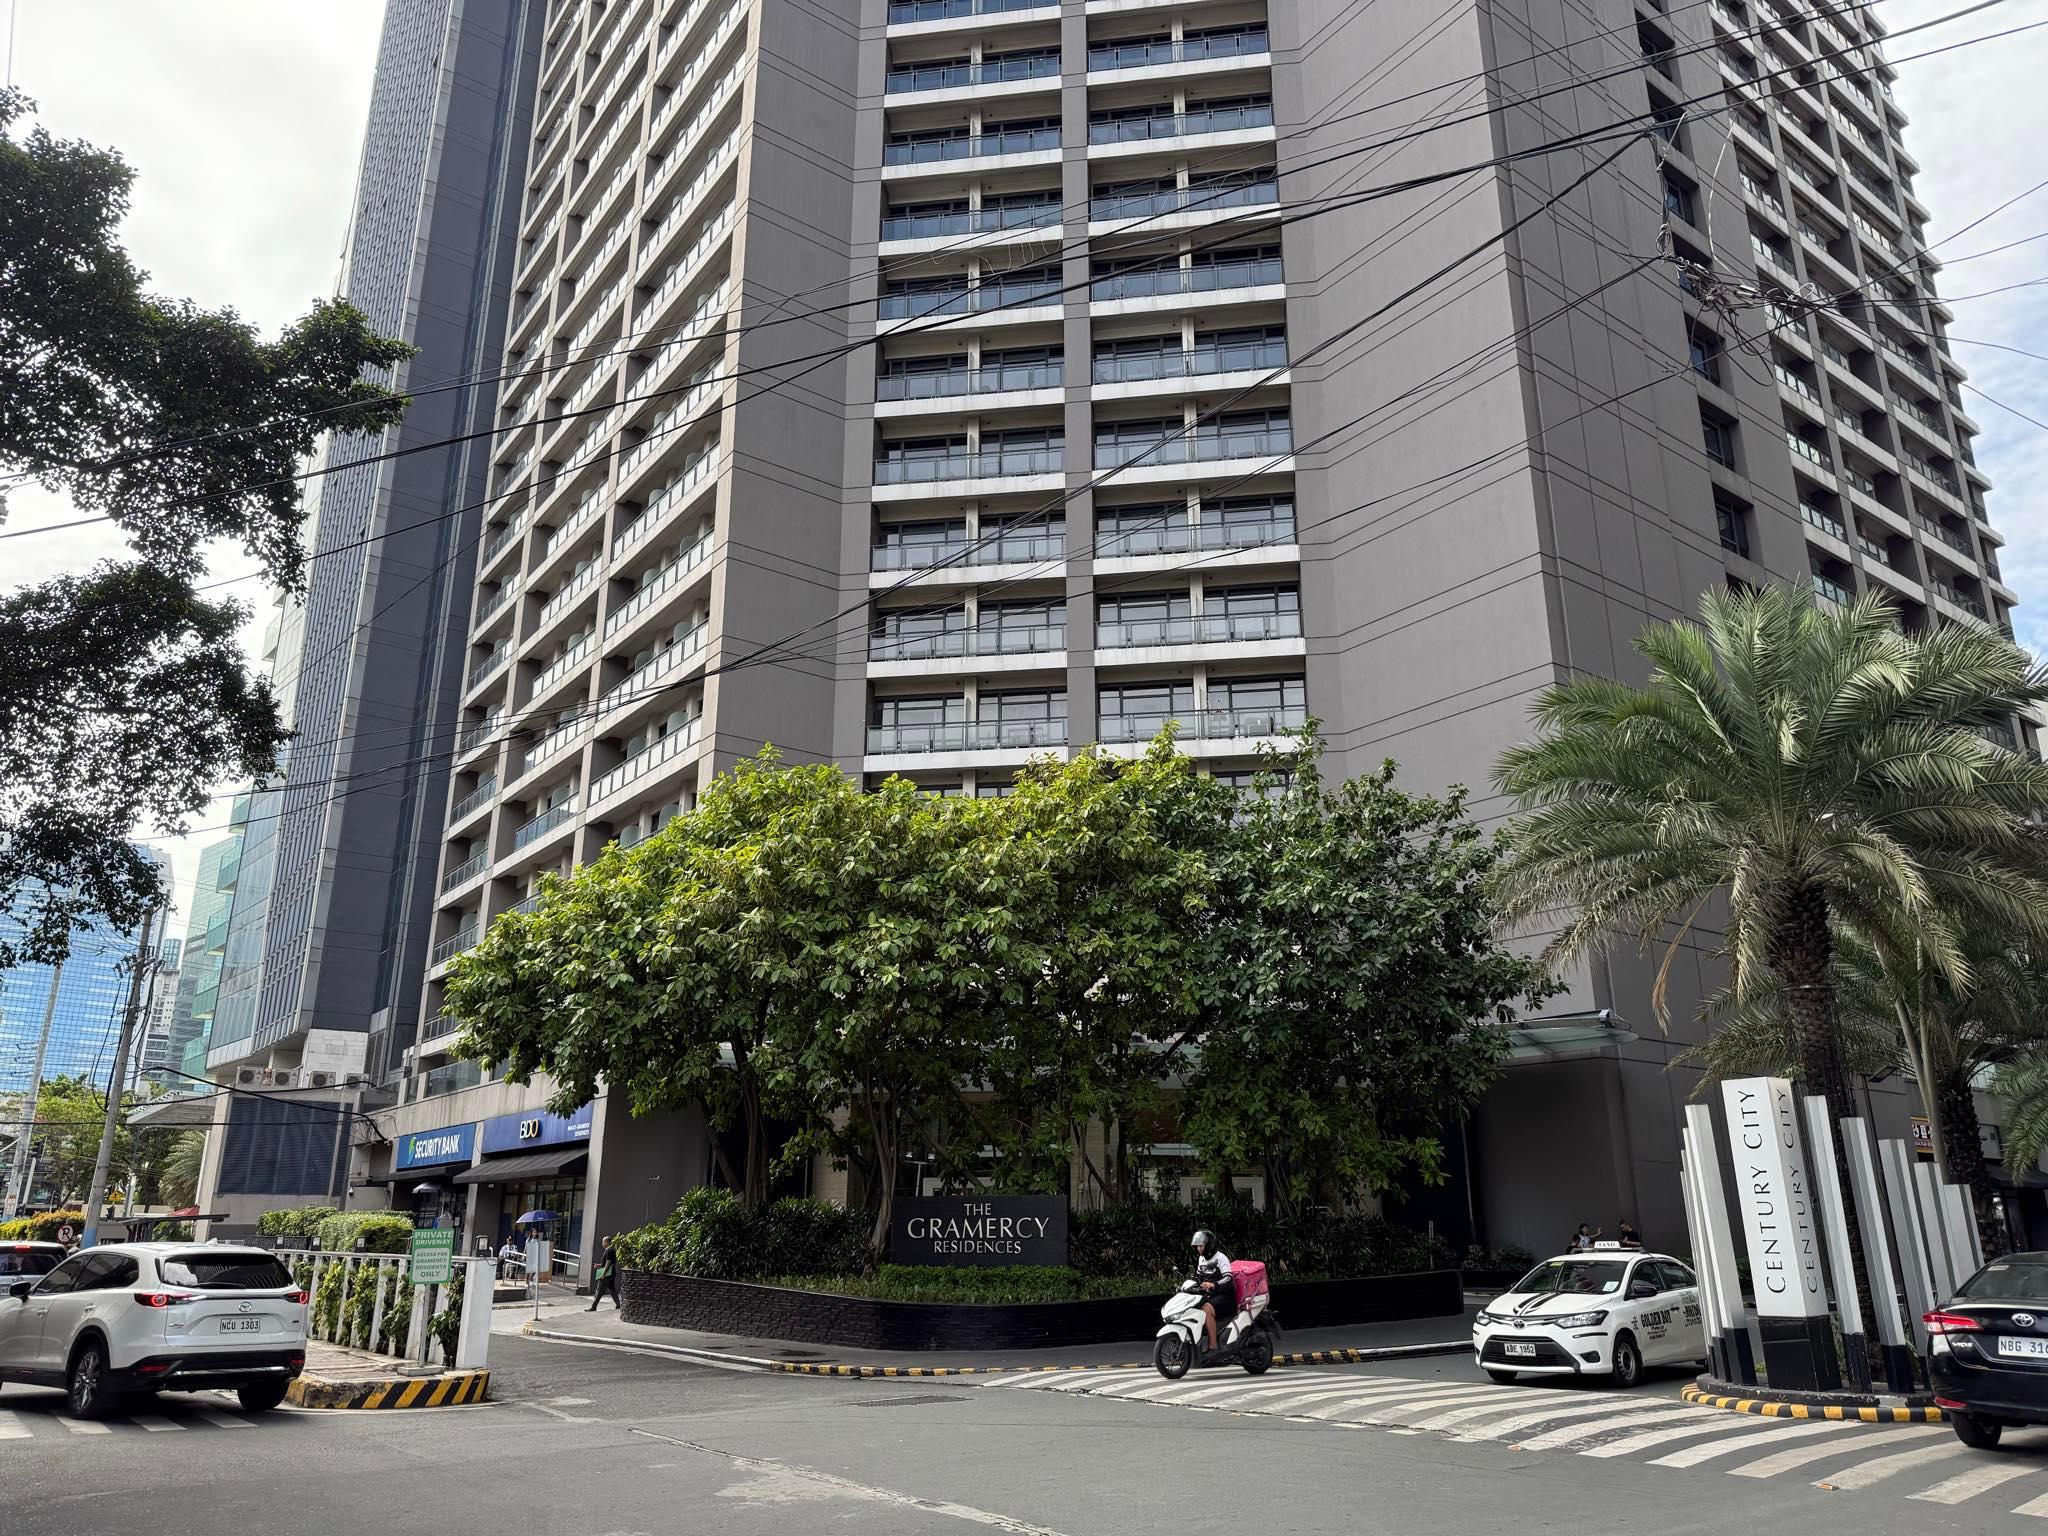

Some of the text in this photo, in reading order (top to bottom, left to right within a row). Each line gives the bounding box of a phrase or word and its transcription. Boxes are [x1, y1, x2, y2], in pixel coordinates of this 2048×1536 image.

[519, 1119, 539, 1139] BDO
[414, 1134, 461, 1159] SECURITY BANK
[1738, 1090, 1786, 1293] CENTURY CITY
[1776, 1089, 1818, 1293] CENTURY CITY
[963, 1203, 992, 1216] THE
[414, 1231, 454, 1239] PRIVATE
[907, 1217, 1050, 1239] GRAMERCY
[934, 1240, 1022, 1254] RESIDENCES
[221, 1320, 259, 1331] NCU 1303
[2000, 1340, 2022, 1352] NBG
